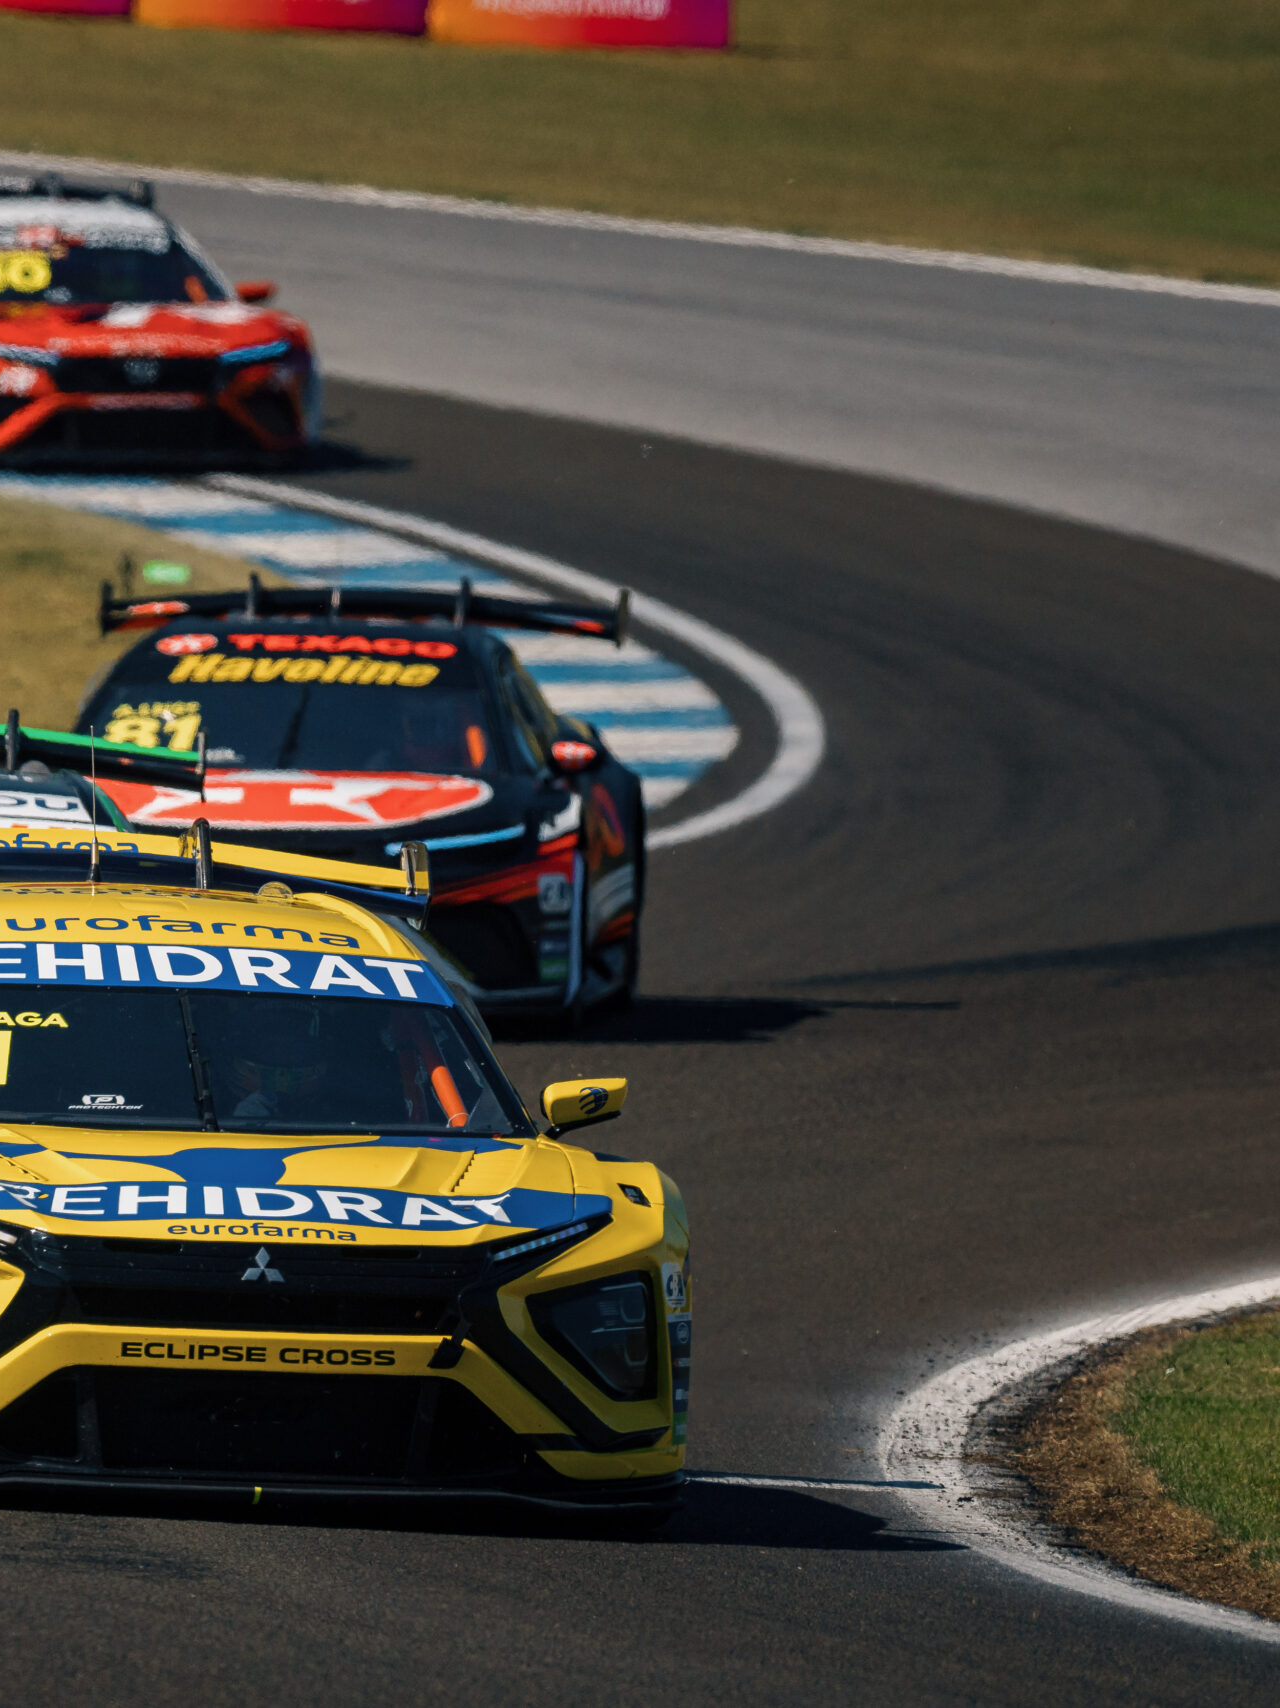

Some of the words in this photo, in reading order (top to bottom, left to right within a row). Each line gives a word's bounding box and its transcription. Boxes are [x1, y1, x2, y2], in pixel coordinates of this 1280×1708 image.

[169, 653, 439, 686] Havoline
[167, 1222, 358, 1242] eurofarma
[121, 1342, 267, 1363] ECLIPSE
[278, 1347, 396, 1366] CROSS
